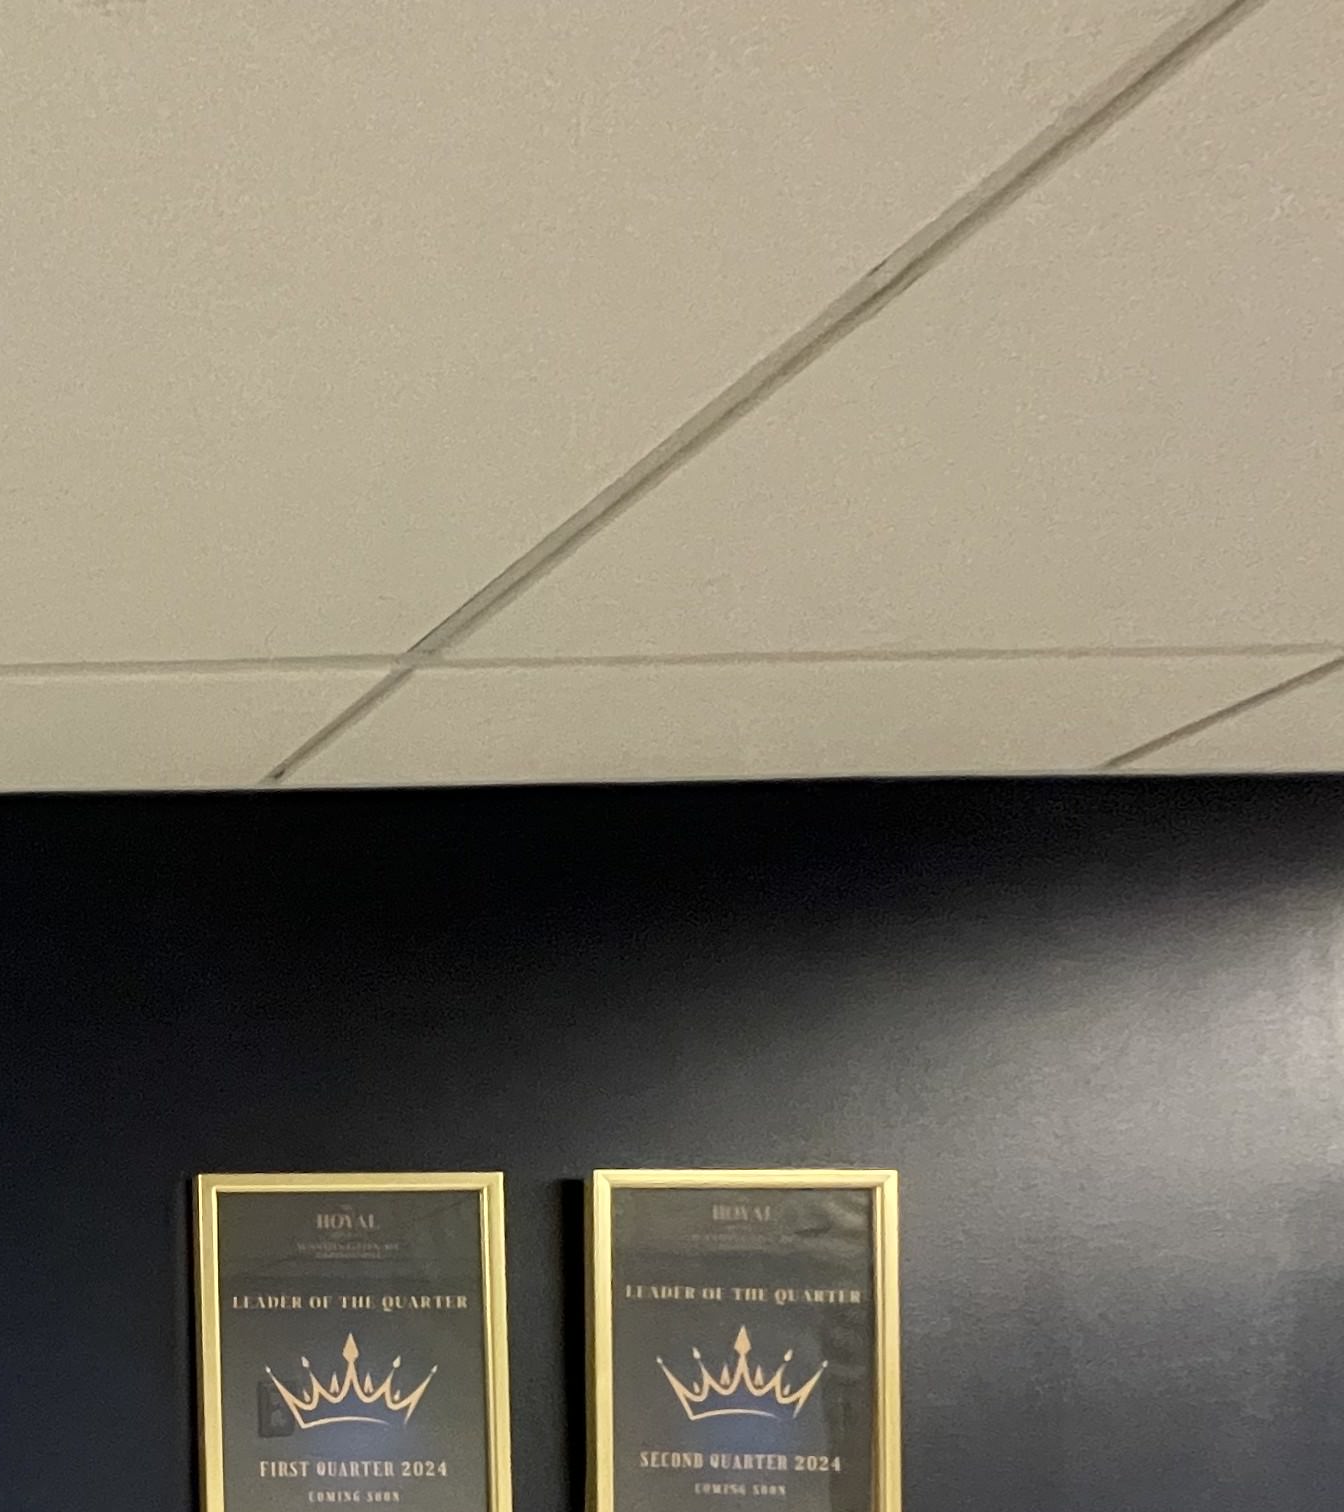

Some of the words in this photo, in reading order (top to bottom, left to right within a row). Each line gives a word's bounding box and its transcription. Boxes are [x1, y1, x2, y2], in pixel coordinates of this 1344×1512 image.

[626, 1285, 695, 1299] LEADER
[702, 1288, 724, 1300] OF
[733, 1288, 767, 1301] THE
[774, 1289, 861, 1305] QUARTER
[233, 1296, 302, 1308] LEADER
[309, 1296, 332, 1308] OF
[341, 1296, 376, 1308] THE
[382, 1296, 467, 1312] QUARTER
[260, 1461, 308, 1477] FIRST
[317, 1461, 394, 1477] QUARTER
[401, 1461, 447, 1476] 2024
[641, 1452, 703, 1468] SECOND
[710, 1454, 787, 1470] QUARTER
[795, 1456, 840, 1471] 2024
